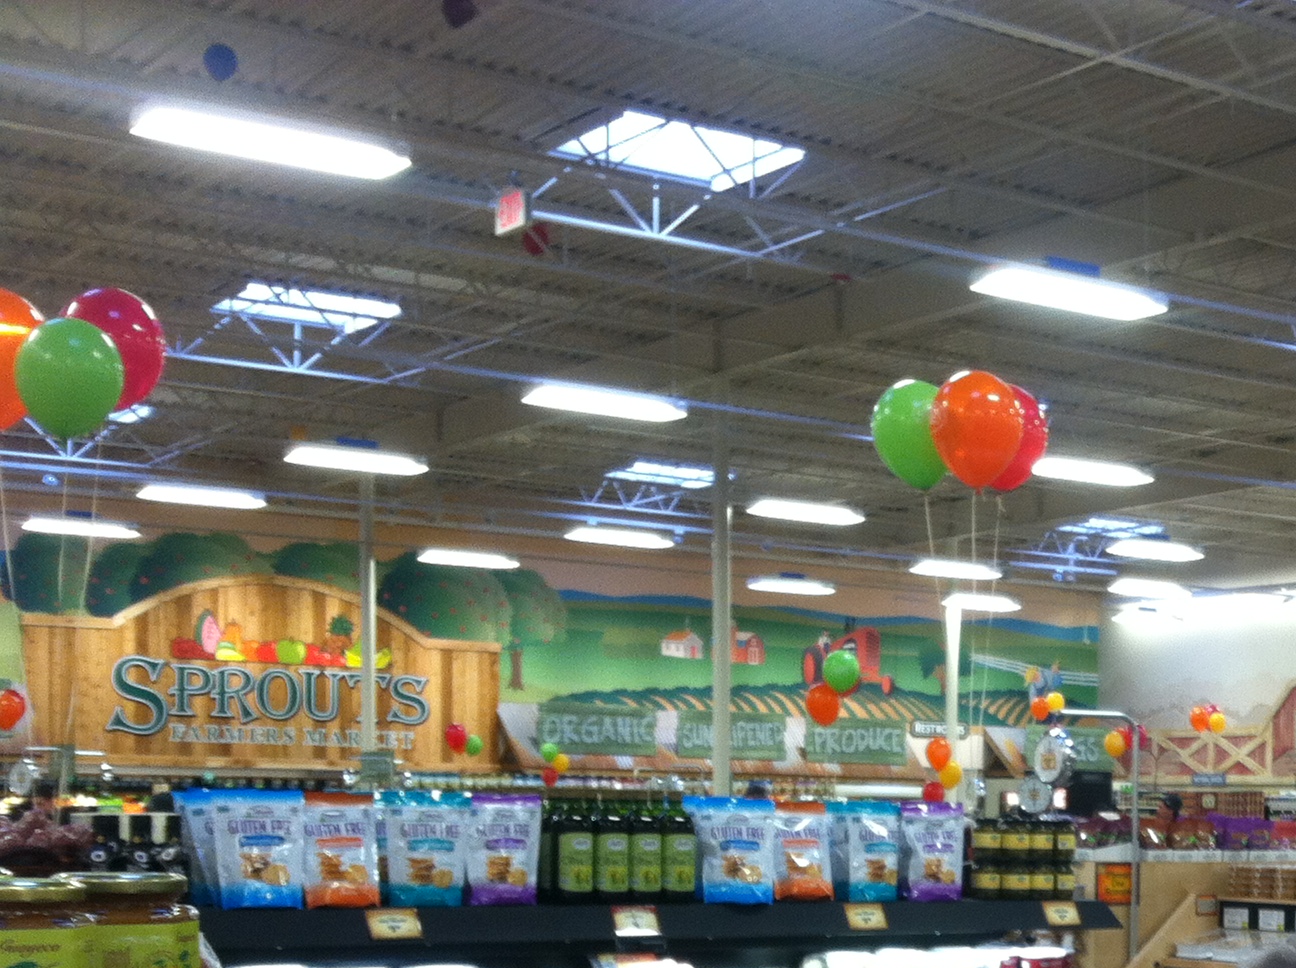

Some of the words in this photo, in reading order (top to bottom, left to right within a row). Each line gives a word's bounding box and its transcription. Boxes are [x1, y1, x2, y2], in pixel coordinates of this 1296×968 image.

[106, 656, 429, 735] SPROUTS
[169, 723, 297, 745] FARMERS
[305, 725, 414, 750] MARET
[541, 714, 655, 744] ORGANIC
[814, 727, 907, 753] PRODUCE
[915, 722, 965, 736] RESTROS
